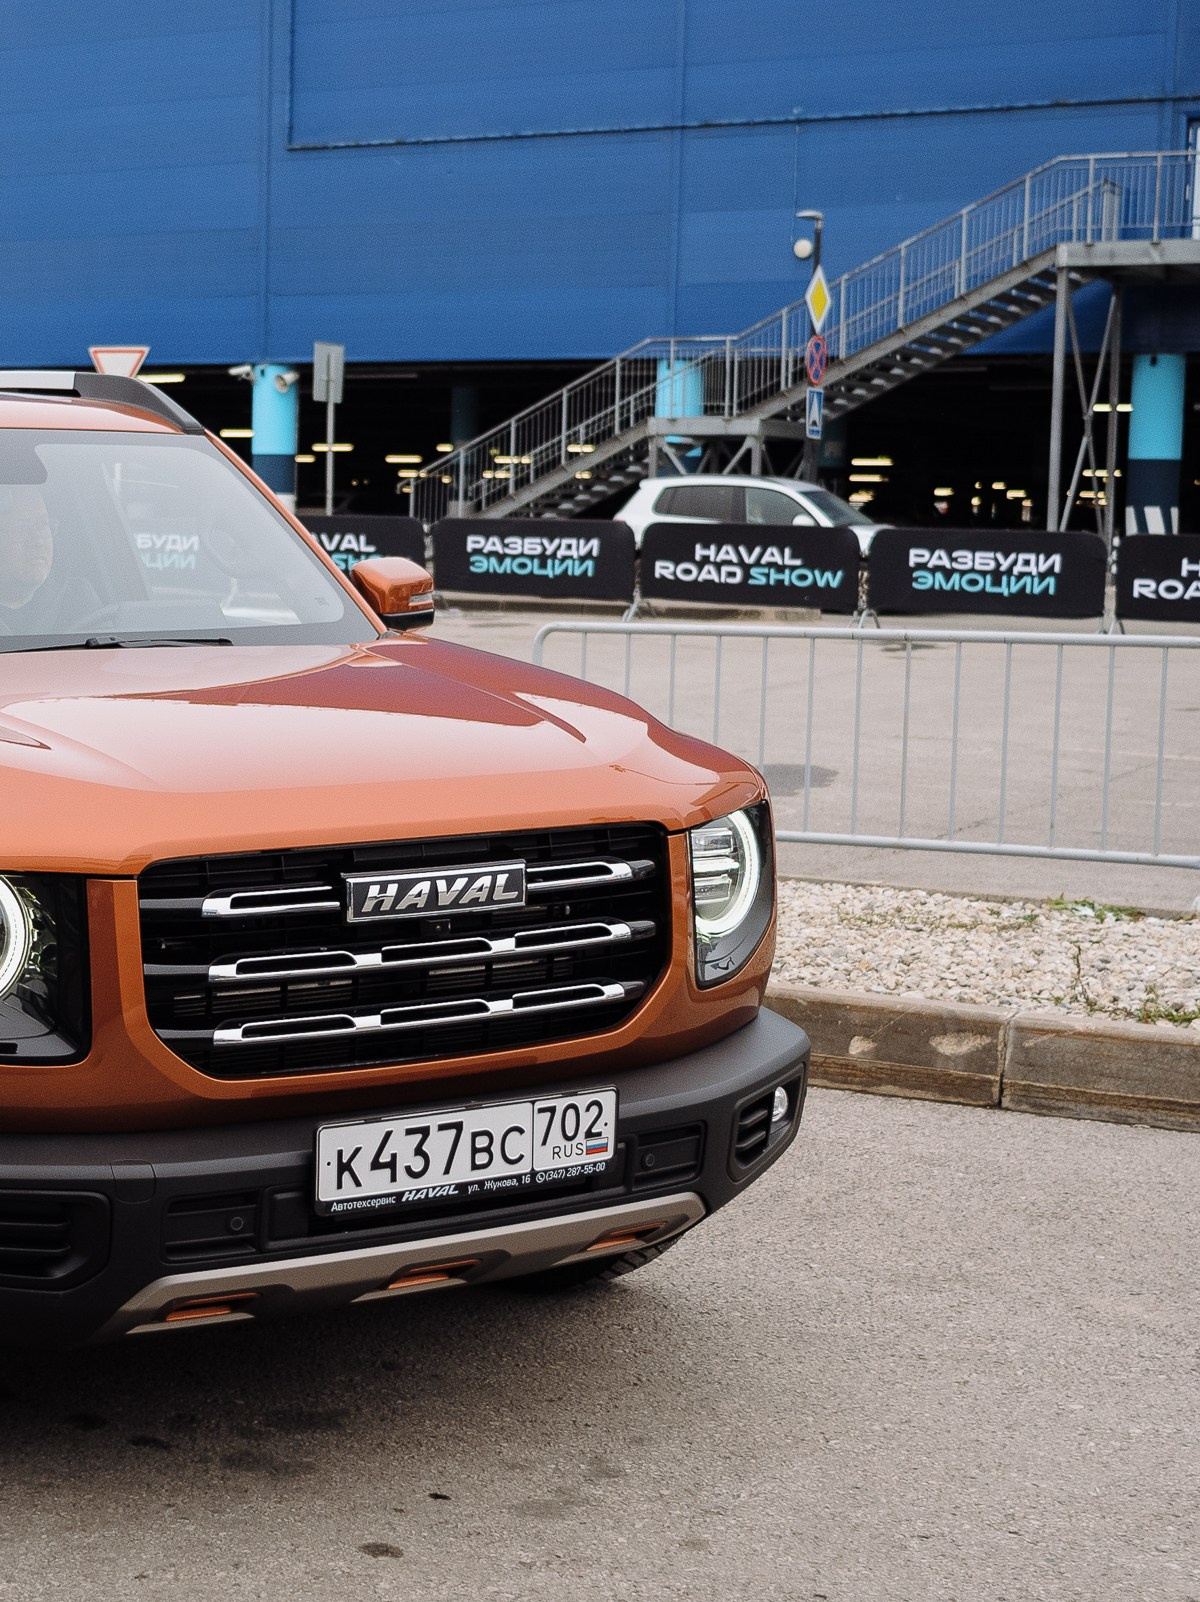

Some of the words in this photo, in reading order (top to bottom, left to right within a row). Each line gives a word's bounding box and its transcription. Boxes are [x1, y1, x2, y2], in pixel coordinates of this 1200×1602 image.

[466, 534, 600, 559] РАЗБУДИ
[694, 542, 804, 566] HAVAL
[469, 554, 596, 579] ЭМОЦИИ
[654, 560, 744, 584] ROAD
[748, 567, 846, 589] SHOW
[908, 547, 1062, 575] РАЗБУДИ
[911, 569, 1056, 597] ЭМОЦИИ
[1132, 577, 1200, 600] ROA
[361, 873, 519, 913] HAVAL
[537, 1099, 604, 1146] 702
[552, 1142, 584, 1160] RUS
[331, 1195, 397, 1212] Автотехсервис
[402, 1184, 459, 1202] HAVAL
[467, 1184, 480, 1195] ул.
[483, 1177, 519, 1191] Жукова,
[521, 1174, 531, 1184] 16
[545, 1170, 566, 1182] (347)
[566, 1161, 606, 1178] 287-55-00
